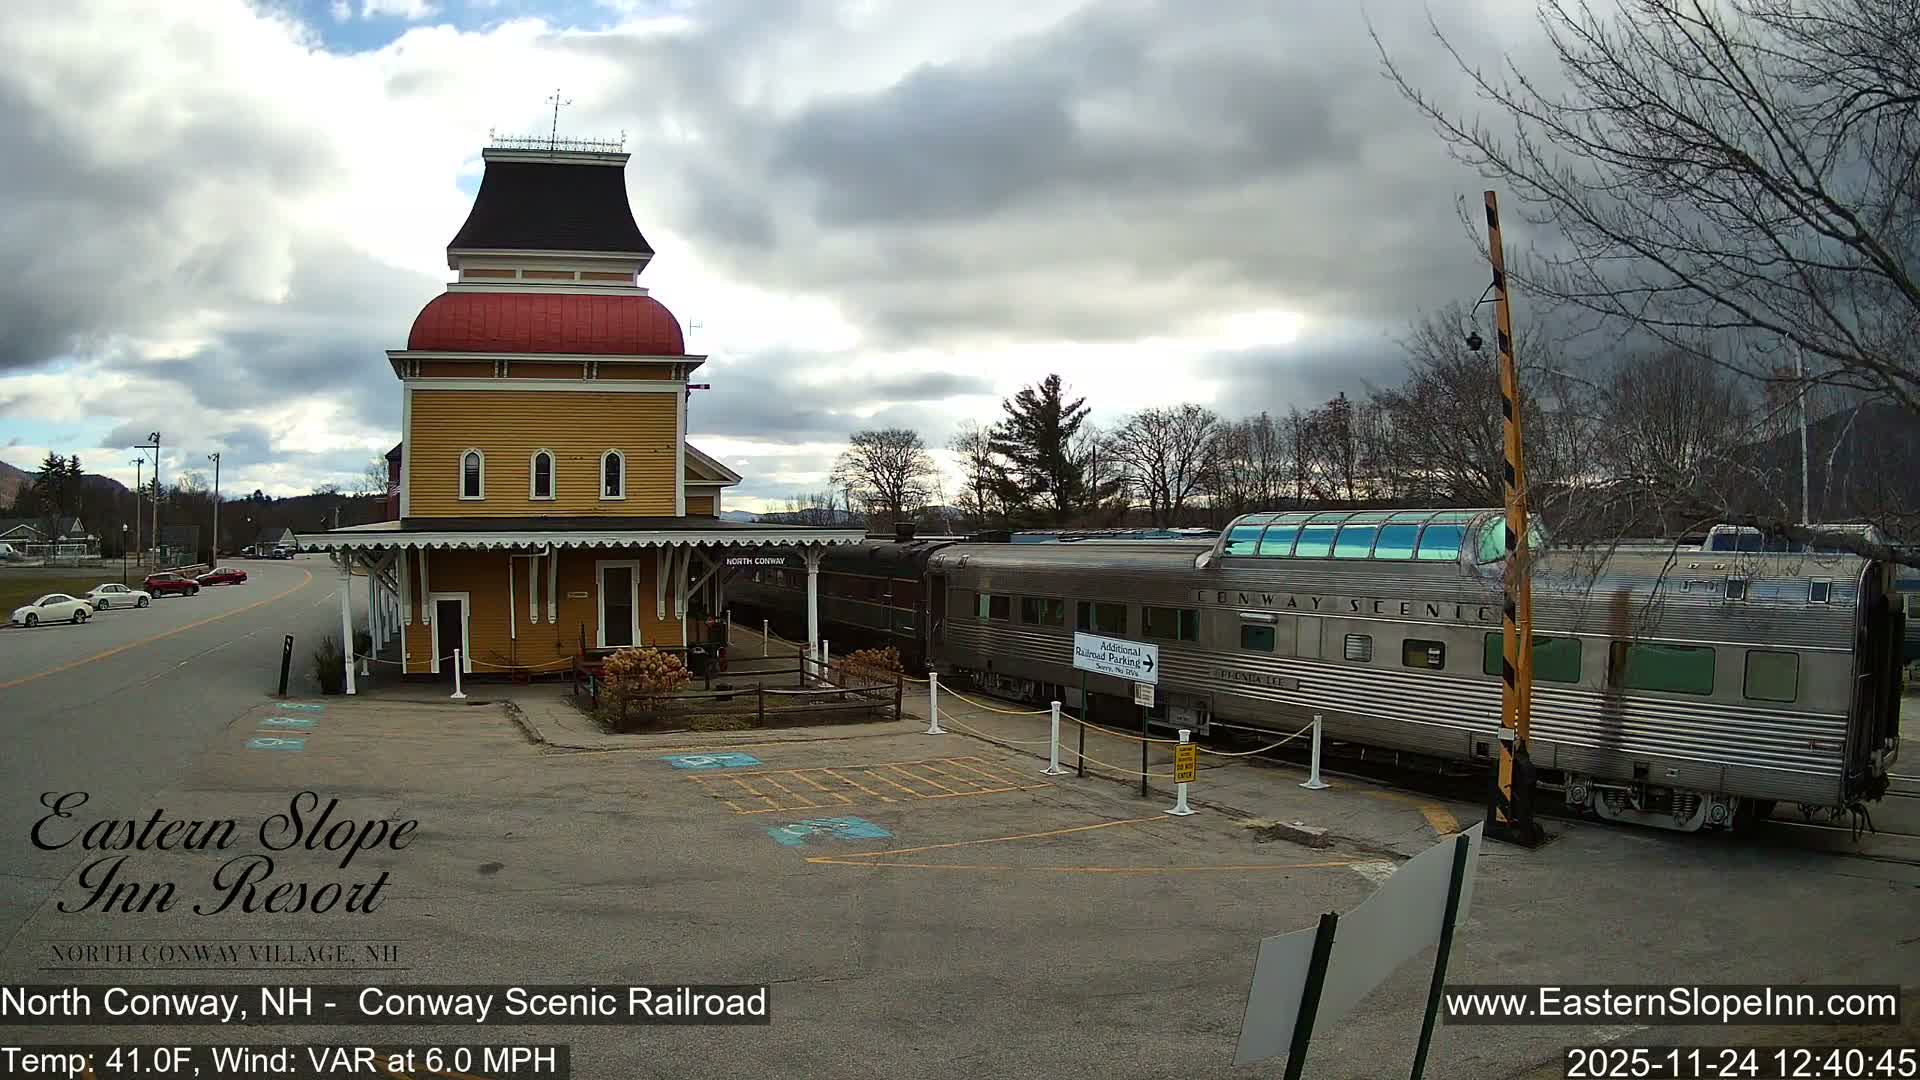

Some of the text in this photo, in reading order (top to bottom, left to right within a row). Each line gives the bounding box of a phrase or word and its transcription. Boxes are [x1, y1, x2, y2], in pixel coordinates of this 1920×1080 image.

[726, 557, 785, 565] NORTH CONWAY
[1198, 590, 1489, 621] CONWAY SCENIC
[1100, 641, 1141, 656] Additional
[1075, 646, 1141, 669] Railroad Parking
[1095, 662, 1114, 673] Sorry,
[1115, 666, 1124, 674] No
